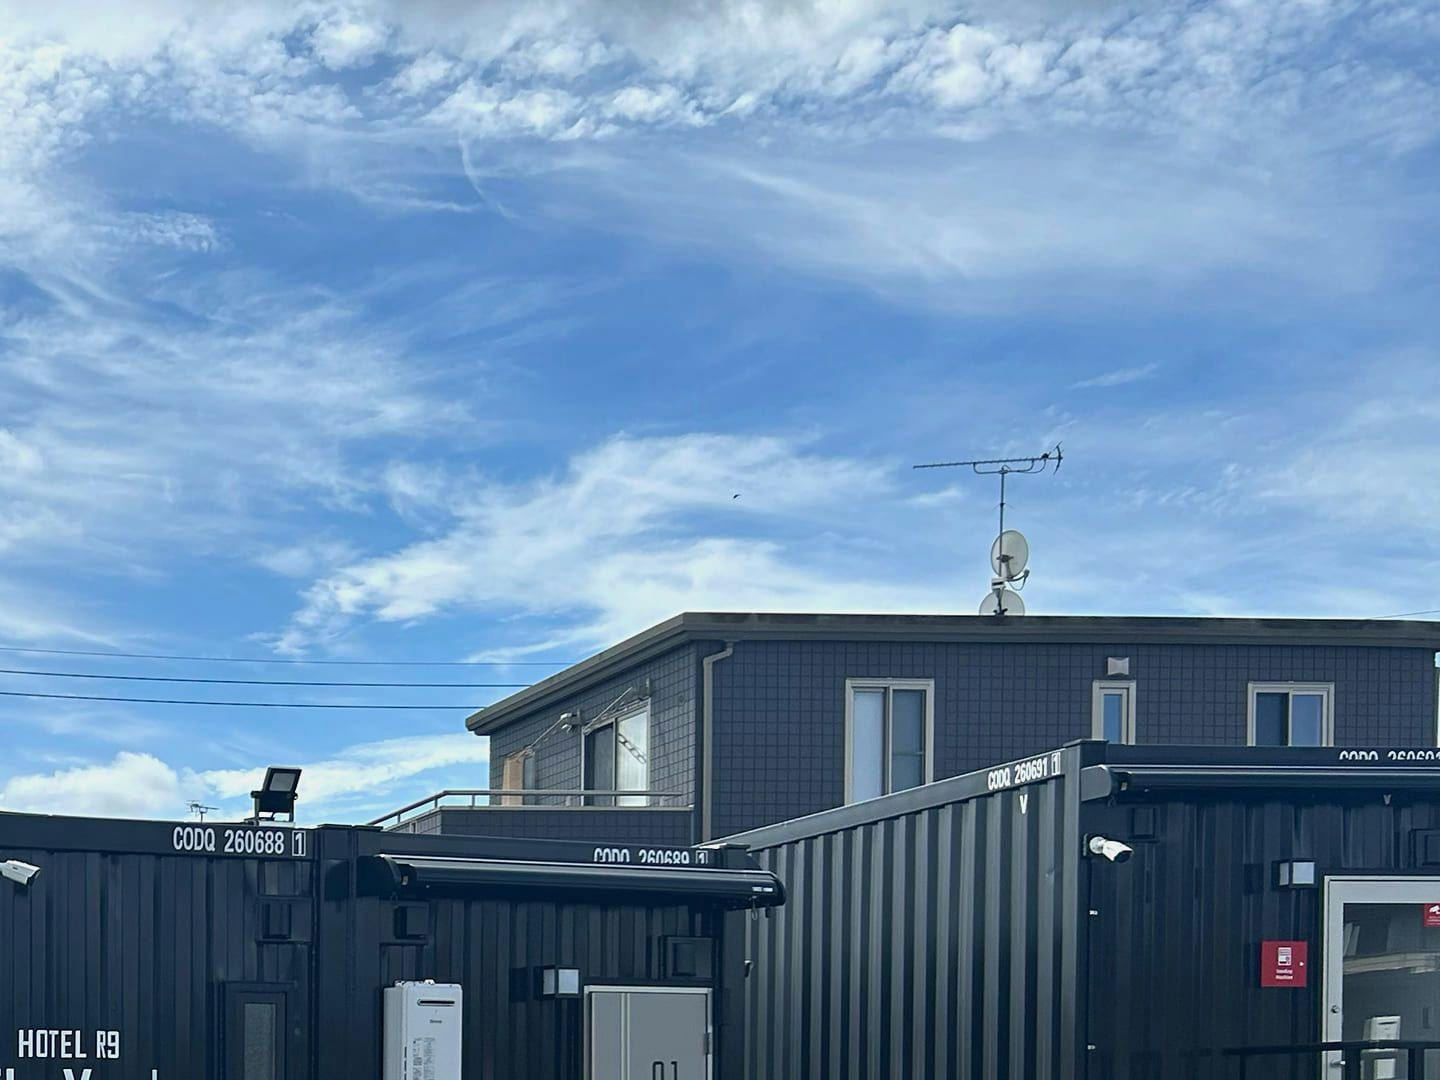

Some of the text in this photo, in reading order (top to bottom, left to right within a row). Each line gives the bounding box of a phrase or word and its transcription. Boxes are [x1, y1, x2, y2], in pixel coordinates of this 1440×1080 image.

[1014, 758, 1048, 783] 260691
[173, 826, 216, 852] CODQ
[224, 829, 284, 854] 260688
[18, 1029, 120, 1059] HOTEL R9
